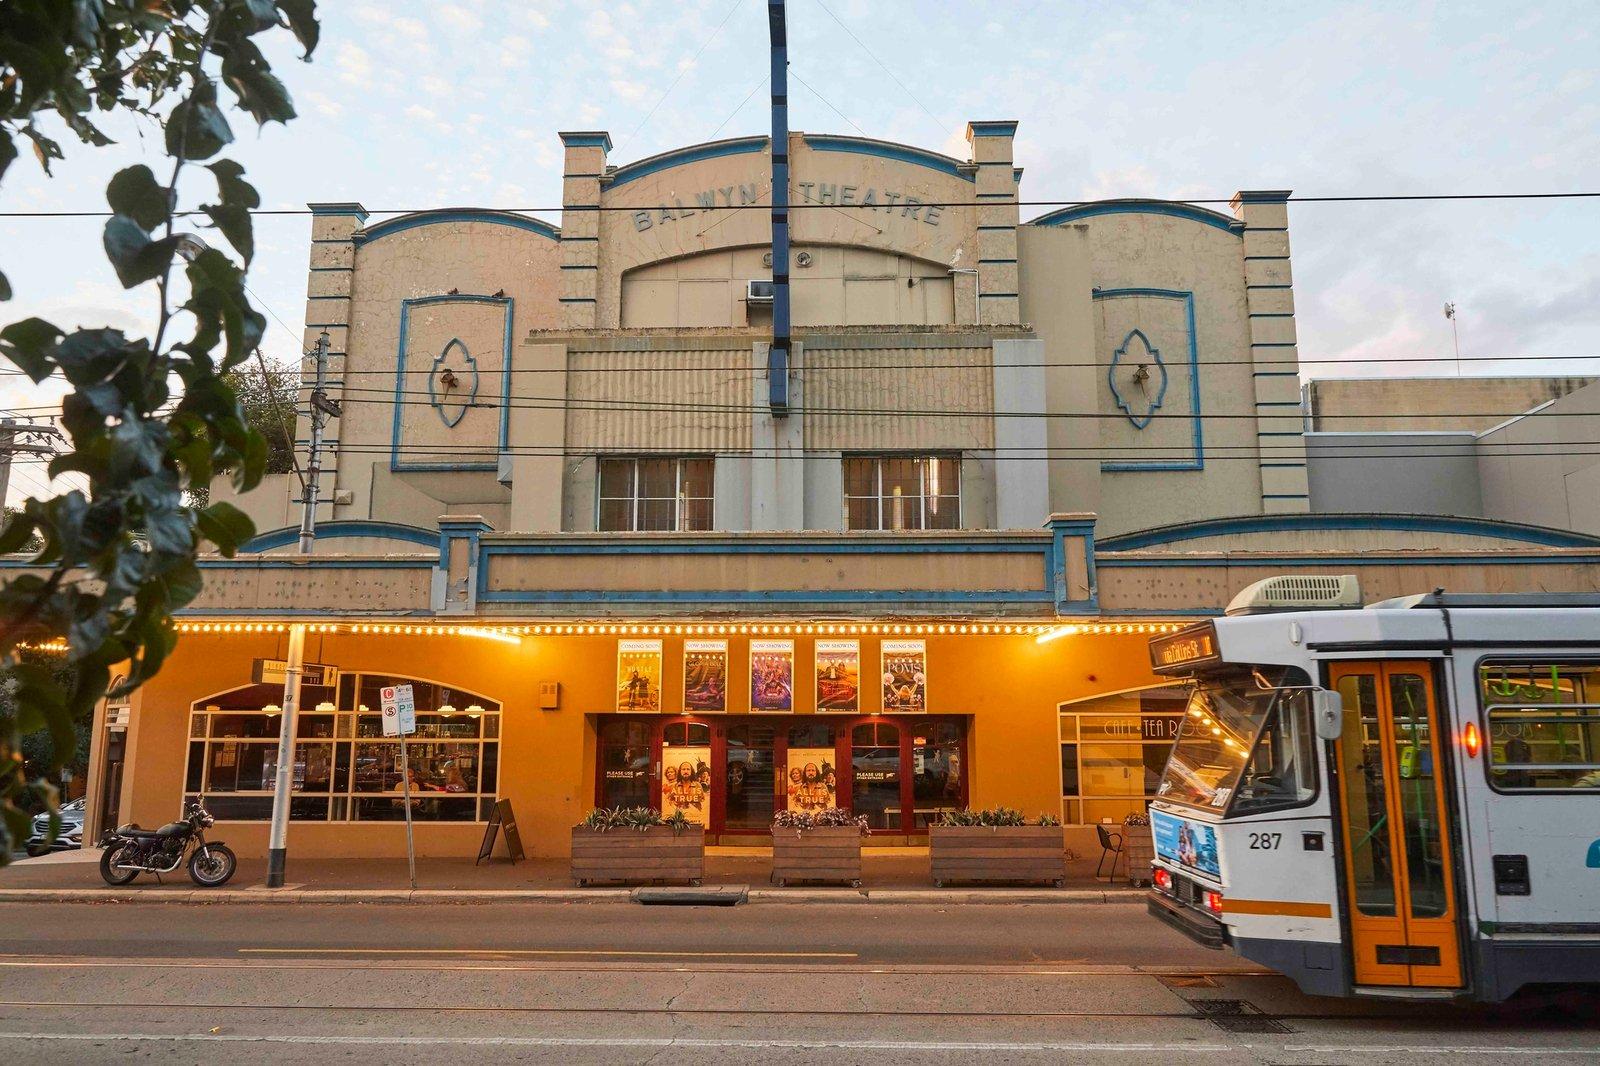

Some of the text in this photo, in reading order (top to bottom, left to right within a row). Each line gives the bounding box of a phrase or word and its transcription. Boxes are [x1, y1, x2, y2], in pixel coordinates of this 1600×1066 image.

[631, 181, 945, 232] BALWYN THEATRE
[887, 662, 921, 674] POMS
[400, 704, 406, 713] P
[1143, 719, 1164, 737] TEA
[1169, 719, 1212, 737] ROO
[671, 787, 691, 795] ALL
[1248, 832, 1282, 850] 287
